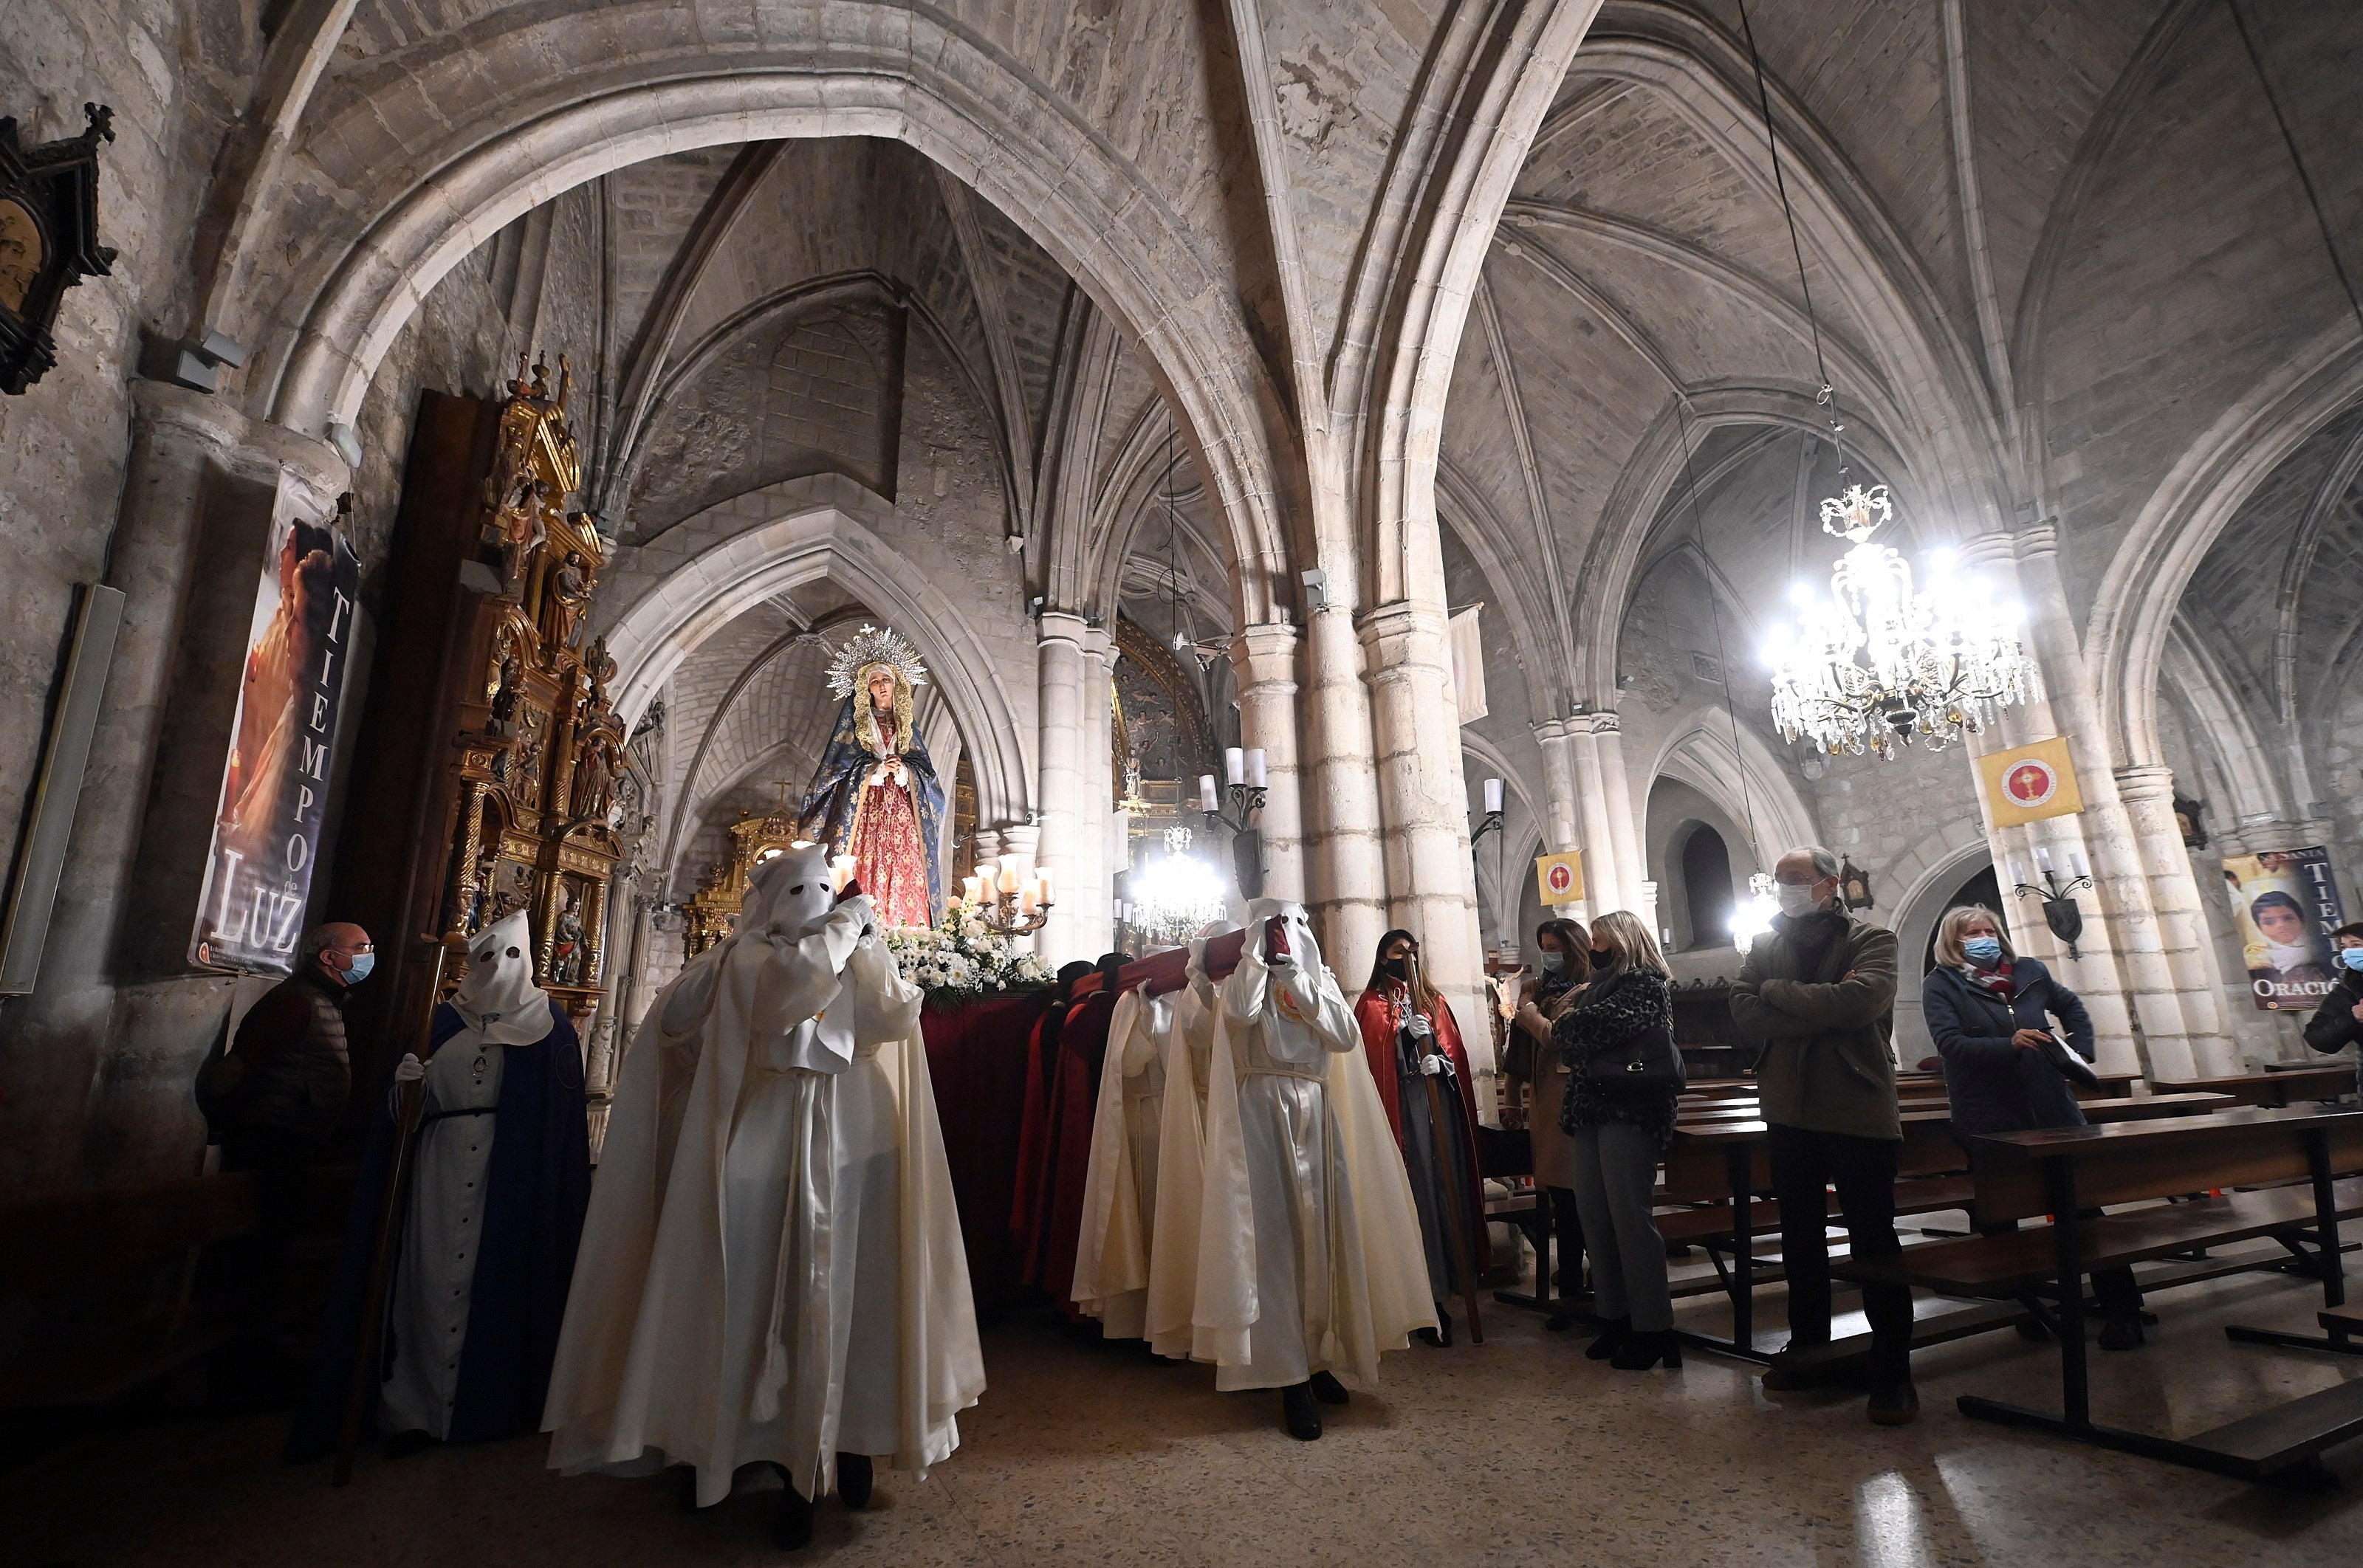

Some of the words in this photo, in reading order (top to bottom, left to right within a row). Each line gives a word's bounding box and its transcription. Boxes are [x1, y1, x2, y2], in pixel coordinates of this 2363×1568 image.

[287, 587, 350, 872] TIEMPO
[210, 848, 302, 953] LUZ
[284, 874, 298, 896] de
[2253, 977, 2340, 997] ORACIÓ
